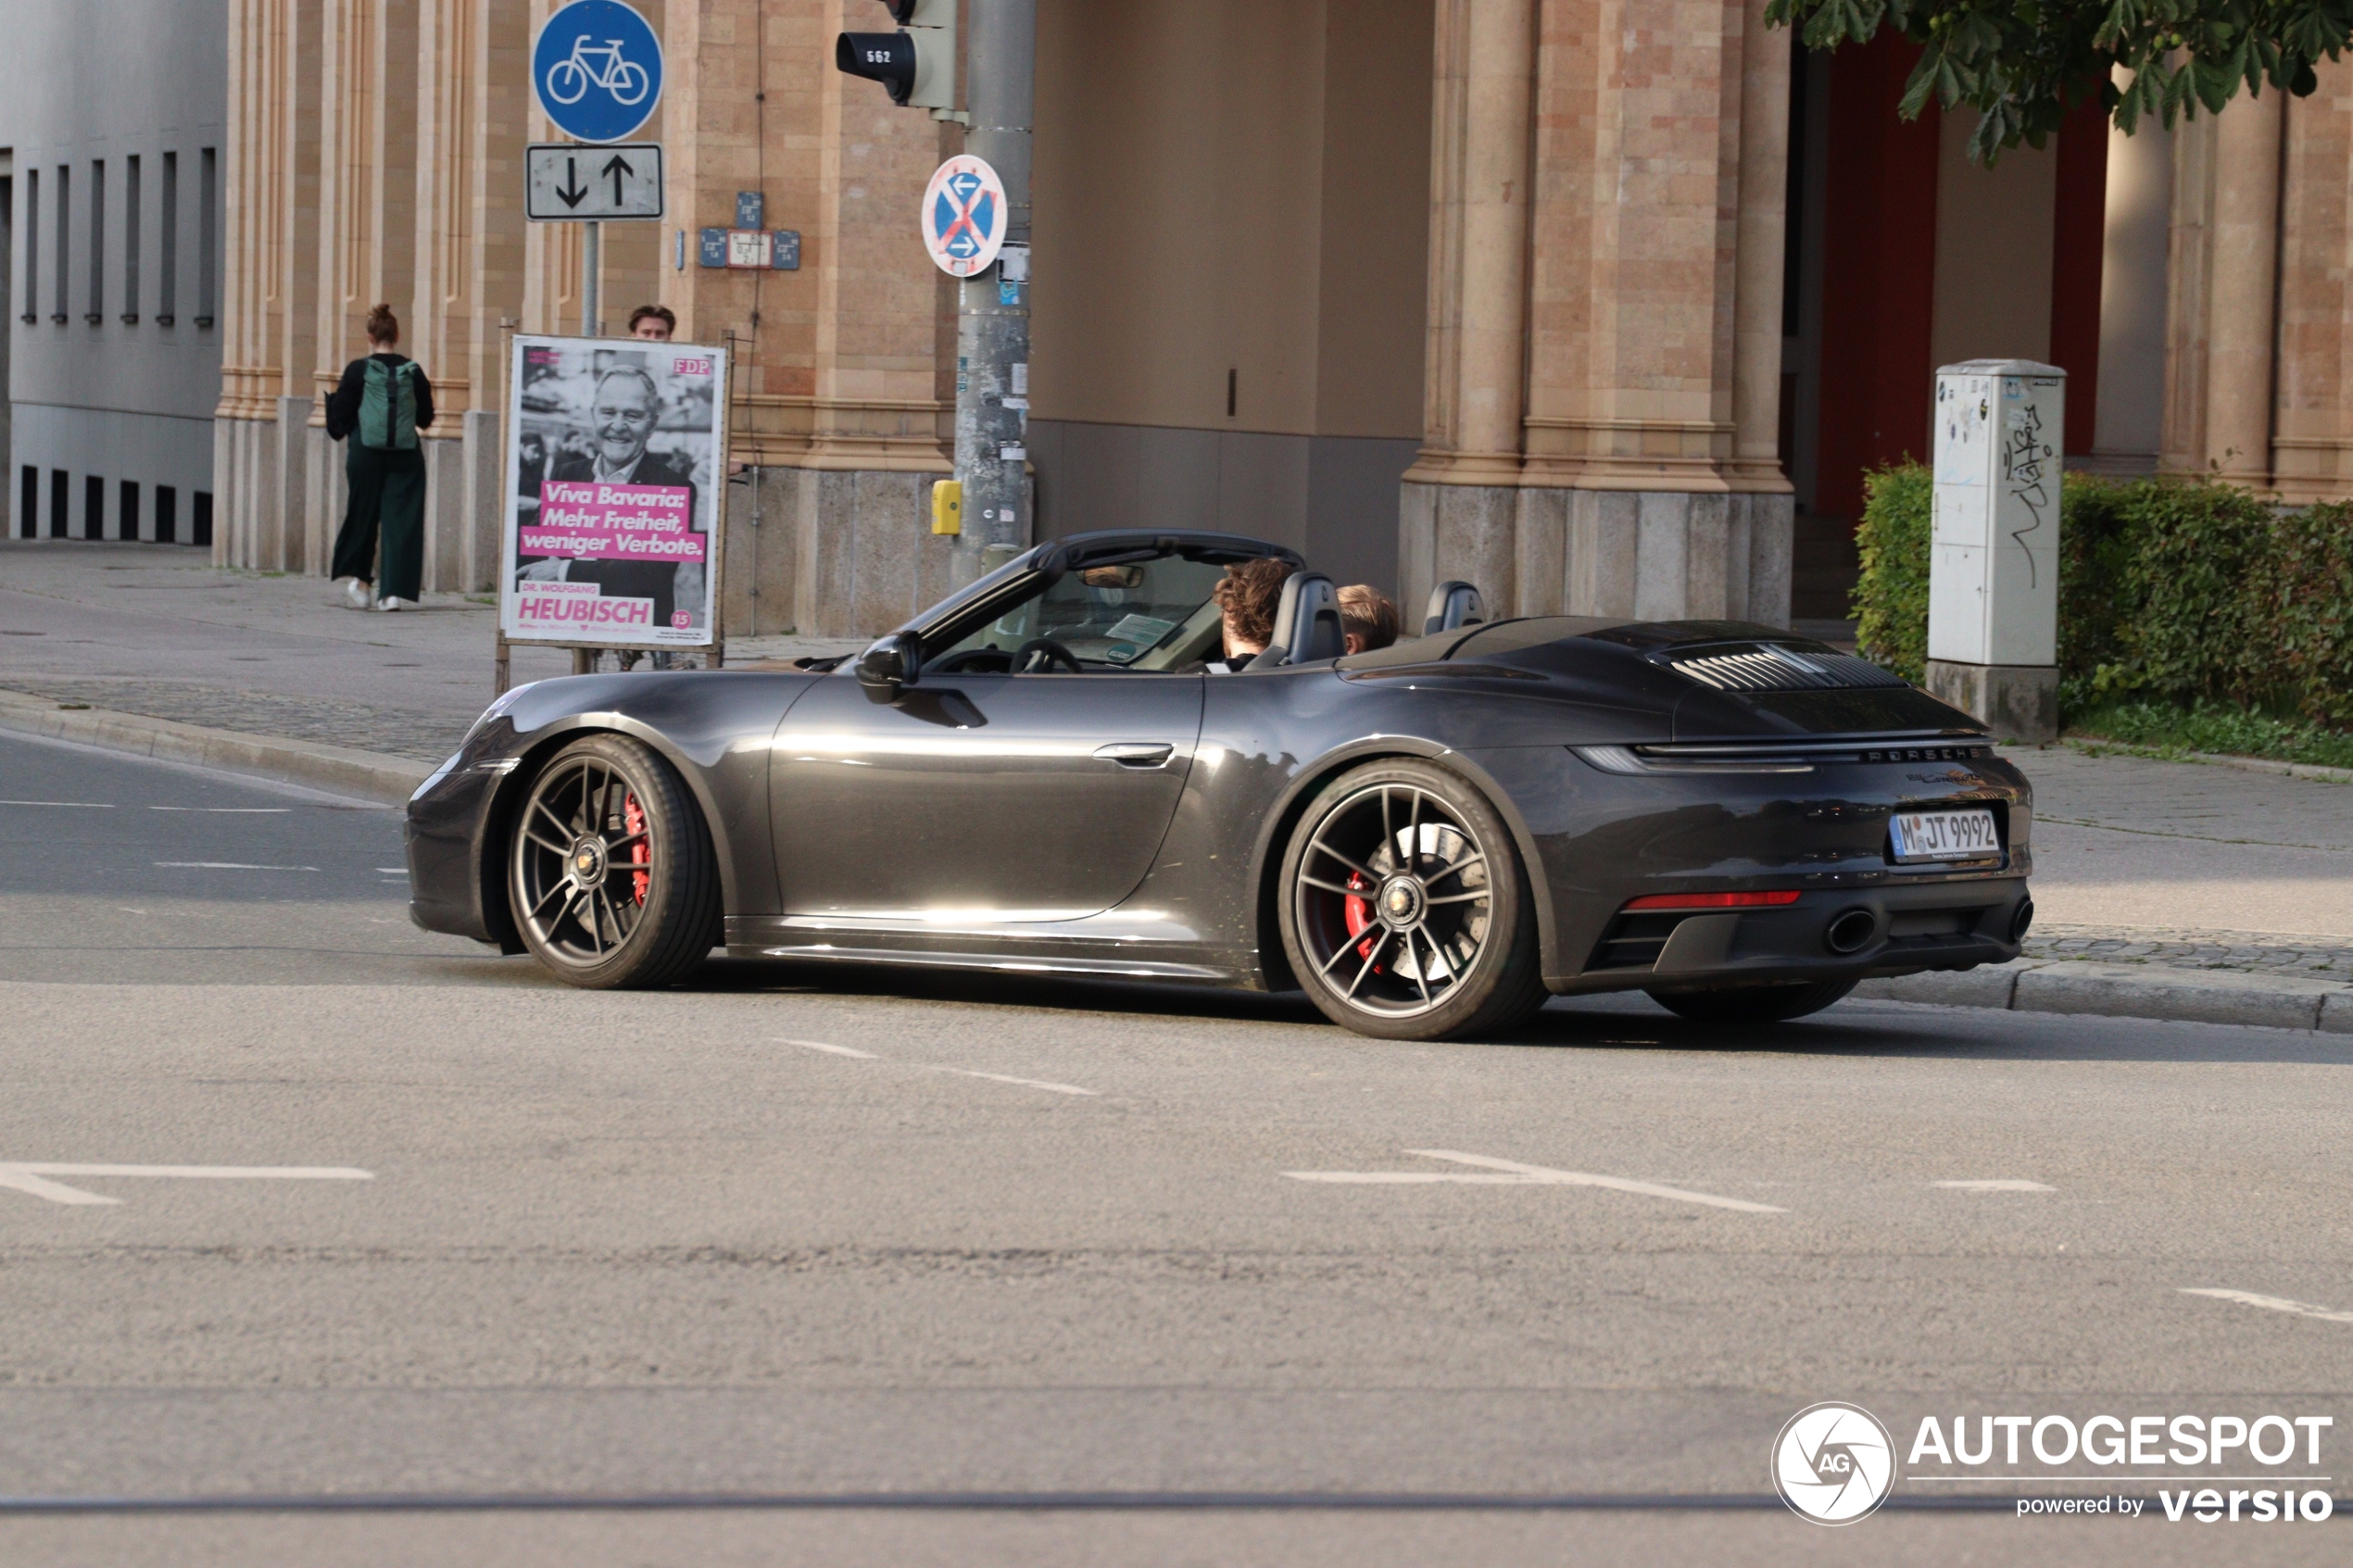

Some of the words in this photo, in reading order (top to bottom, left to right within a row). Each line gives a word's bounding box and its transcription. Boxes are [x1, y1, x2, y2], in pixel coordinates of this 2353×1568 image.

[867, 50, 891, 63] 562
[675, 359, 710, 374] FDP
[546, 483, 593, 504] Viva
[598, 486, 686, 508] Bavaria:
[543, 508, 599, 529] Mehr
[603, 511, 684, 534] Freiheit,
[523, 531, 610, 556] weniger
[615, 533, 703, 556] Verbote.
[522, 583, 537, 592] DR.
[541, 583, 597, 594] WOLFGANG
[519, 597, 649, 624] HEUBISCH
[674, 615, 688, 625] 15
[1869, 748, 1981, 761] PORSCHE
[1899, 818, 1916, 850] M
[1925, 816, 1946, 849] JT
[1950, 815, 1994, 847] 9992
